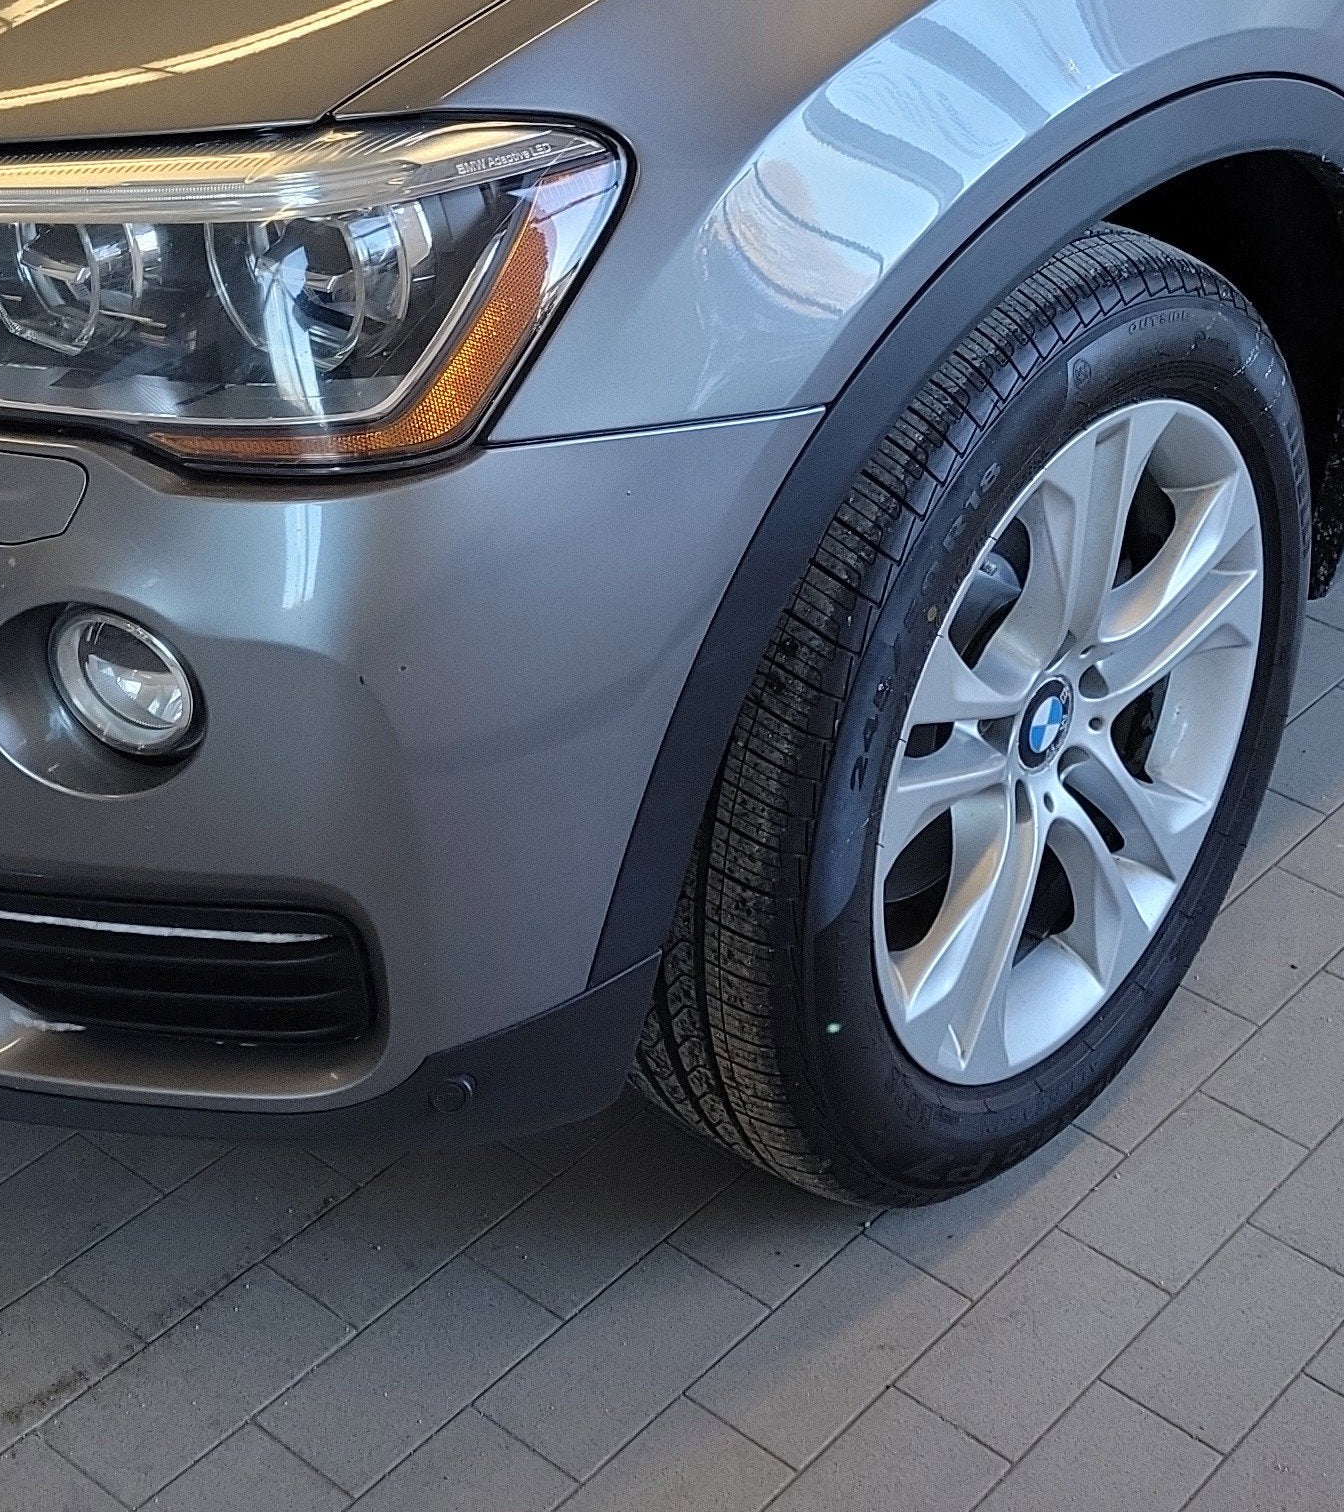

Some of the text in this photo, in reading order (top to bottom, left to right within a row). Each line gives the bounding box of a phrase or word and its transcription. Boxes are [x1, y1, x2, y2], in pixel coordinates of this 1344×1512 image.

[456, 143, 552, 175] BMW Adaptive LED
